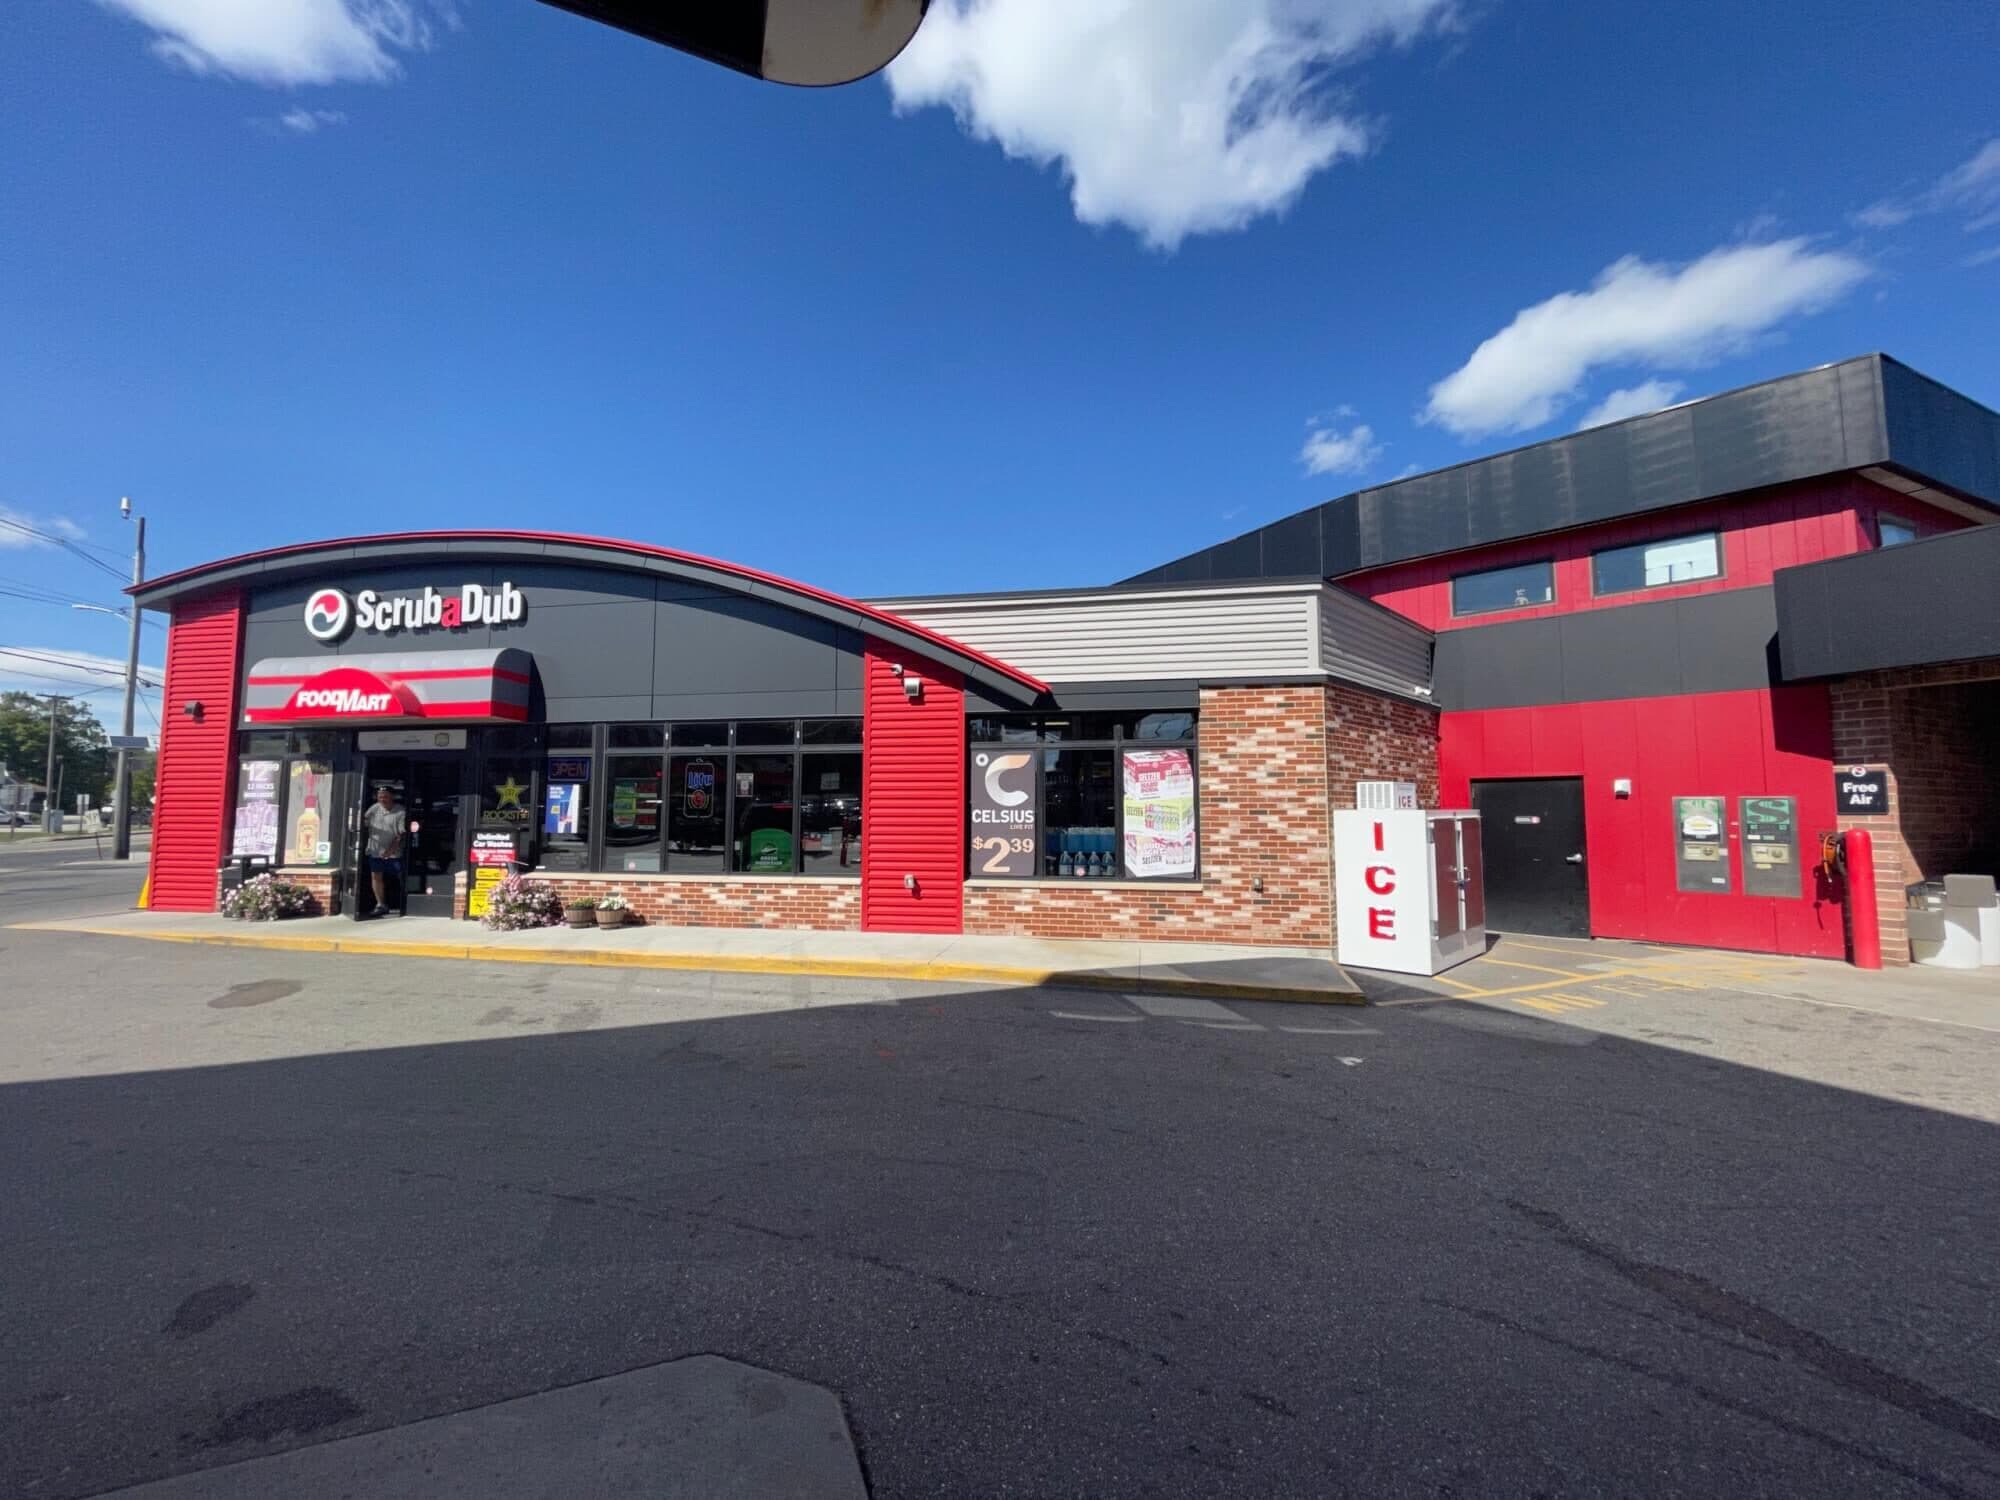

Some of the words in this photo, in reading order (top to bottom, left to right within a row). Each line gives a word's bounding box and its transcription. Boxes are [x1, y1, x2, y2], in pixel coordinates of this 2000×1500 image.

[356, 581, 522, 631] ScrubaDub
[1843, 782, 1878, 793] Free
[1850, 794, 1873, 805] Air
[972, 809, 1034, 824] CELSIUS
[1365, 821, 1397, 940] ICE
